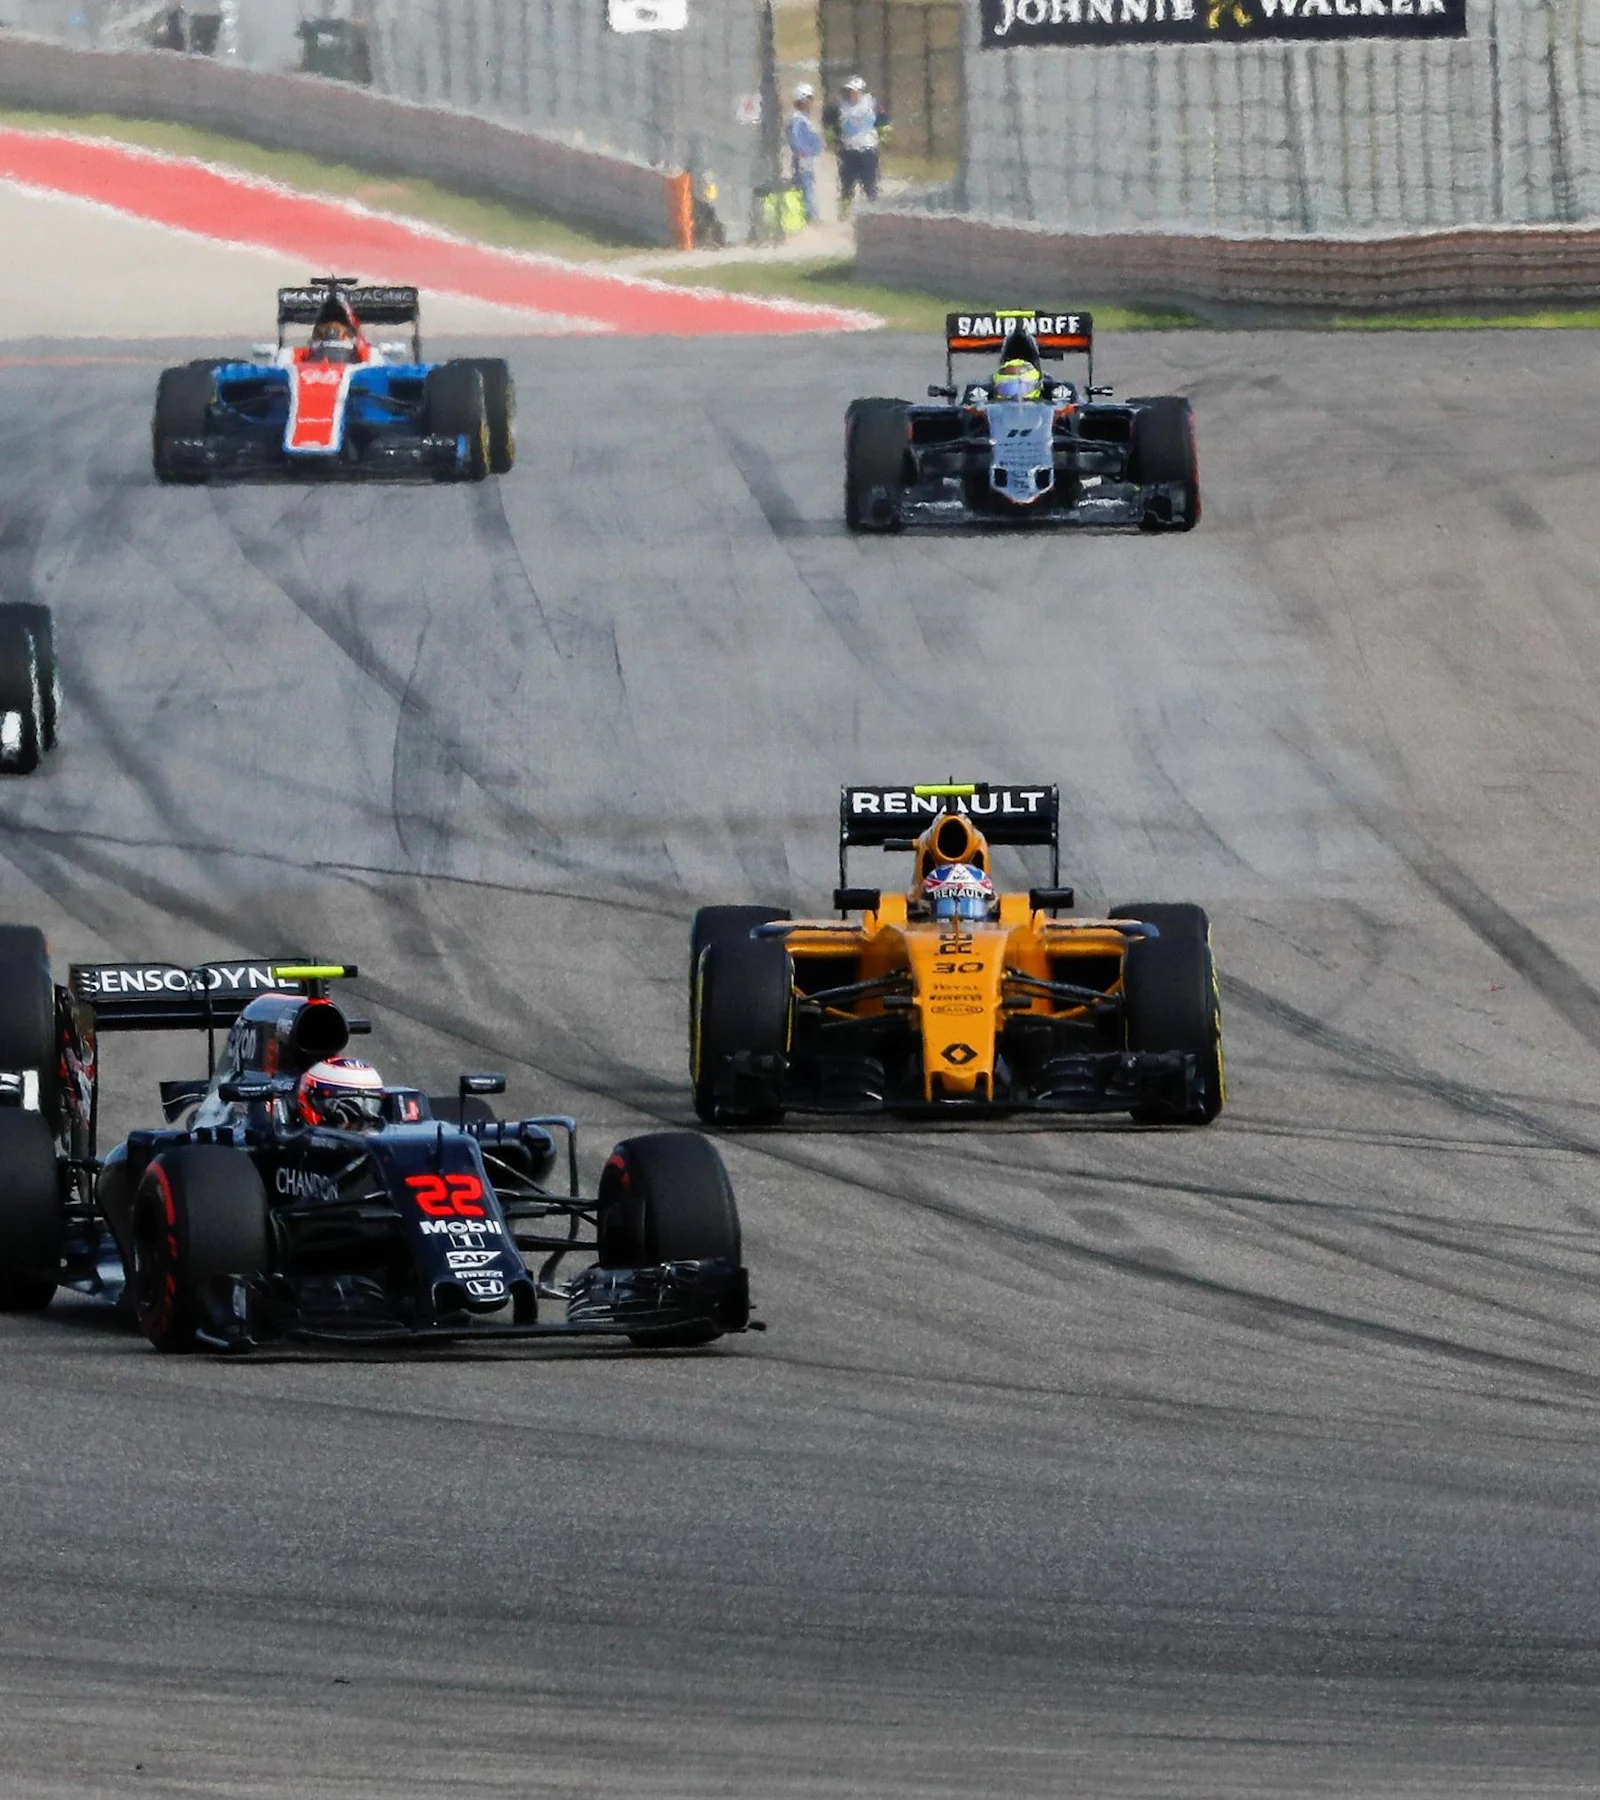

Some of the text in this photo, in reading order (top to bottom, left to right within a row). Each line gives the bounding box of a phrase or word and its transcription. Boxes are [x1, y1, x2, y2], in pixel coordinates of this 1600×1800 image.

[934, 889, 985, 899] RENAULT
[933, 962, 984, 974] 30
[276, 1167, 339, 1201] CHANDON
[405, 1174, 485, 1216] 22
[419, 1220, 502, 1235] Mobil
